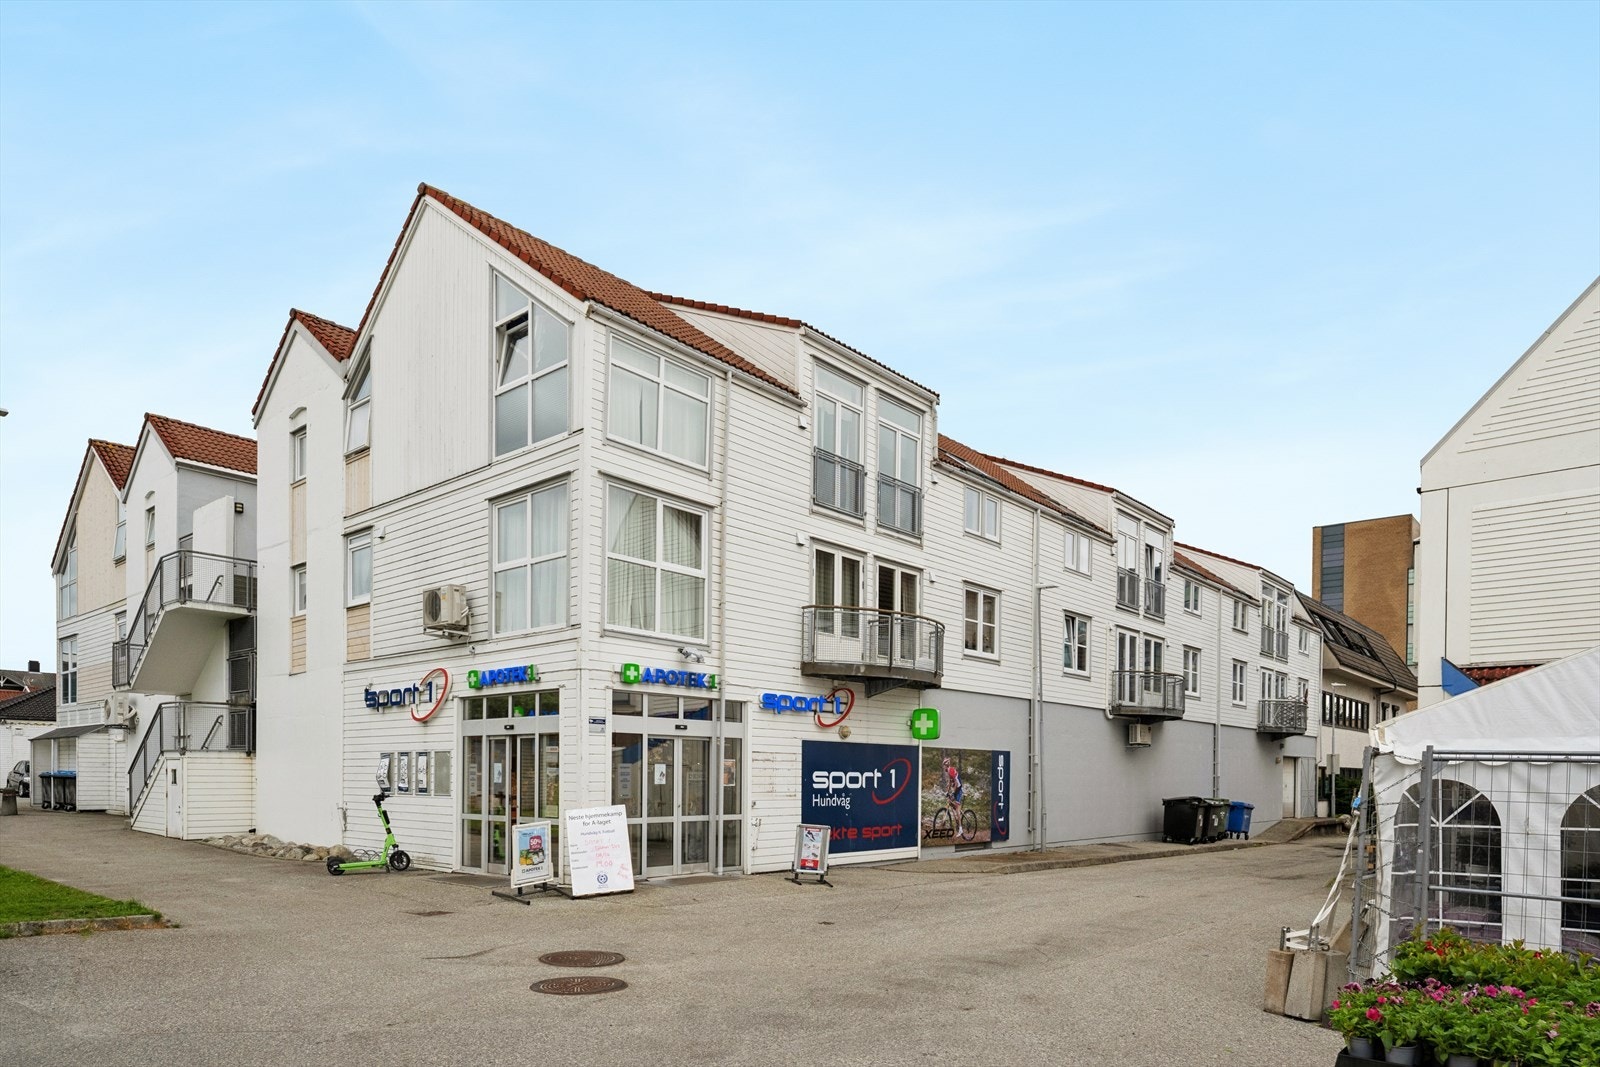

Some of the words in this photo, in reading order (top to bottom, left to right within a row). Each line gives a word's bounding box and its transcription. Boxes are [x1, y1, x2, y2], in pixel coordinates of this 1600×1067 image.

[480, 665, 527, 687] APOTEK
[528, 664, 536, 682] 1
[641, 667, 708, 689] APOTEK
[708, 674, 718, 689] 1
[364, 683, 419, 712] sport
[427, 681, 433, 703] 1
[762, 692, 828, 714] sport
[832, 696, 841, 714] 1
[812, 768, 882, 793] sport
[889, 768, 896, 789] 1
[812, 793, 851, 809] Hundvåg
[584, 811, 623, 820] hjemmekamp
[862, 824, 902, 841] sport
[923, 828, 955, 839] XEED
